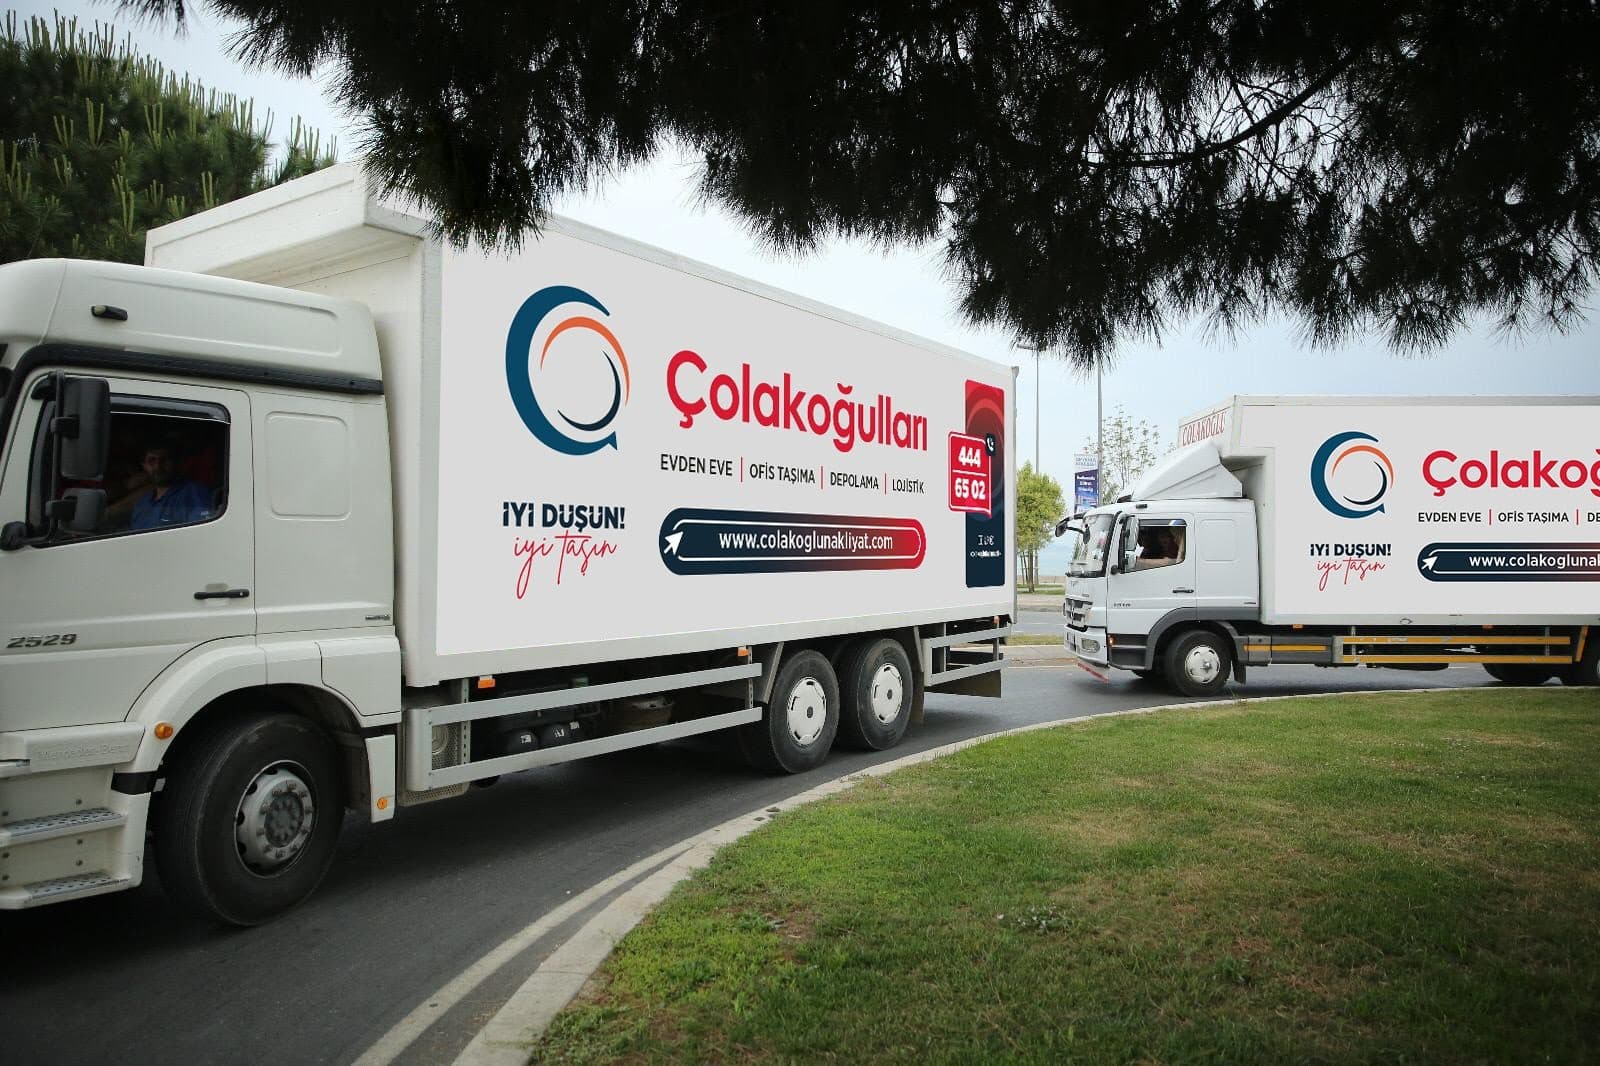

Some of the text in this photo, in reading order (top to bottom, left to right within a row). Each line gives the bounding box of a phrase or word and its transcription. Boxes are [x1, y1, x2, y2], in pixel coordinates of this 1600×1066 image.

[666, 350, 928, 453] Çolakoğulları
[660, 453, 733, 476] EVDEN EVE
[958, 445, 981, 468] 444
[749, 461, 815, 485] OFİS TAŞIMA
[829, 471, 879, 490] DEPOLAMA
[892, 478, 925, 494] LOJİSTİK
[955, 477, 986, 500] 65 02
[1418, 511, 1481, 523] EVDEN EVE
[1498, 510, 1569, 525] OFİS TAŞIMA
[718, 529, 893, 553] www.colakoglunakliyat.com
[6, 633, 77, 649] 2529
